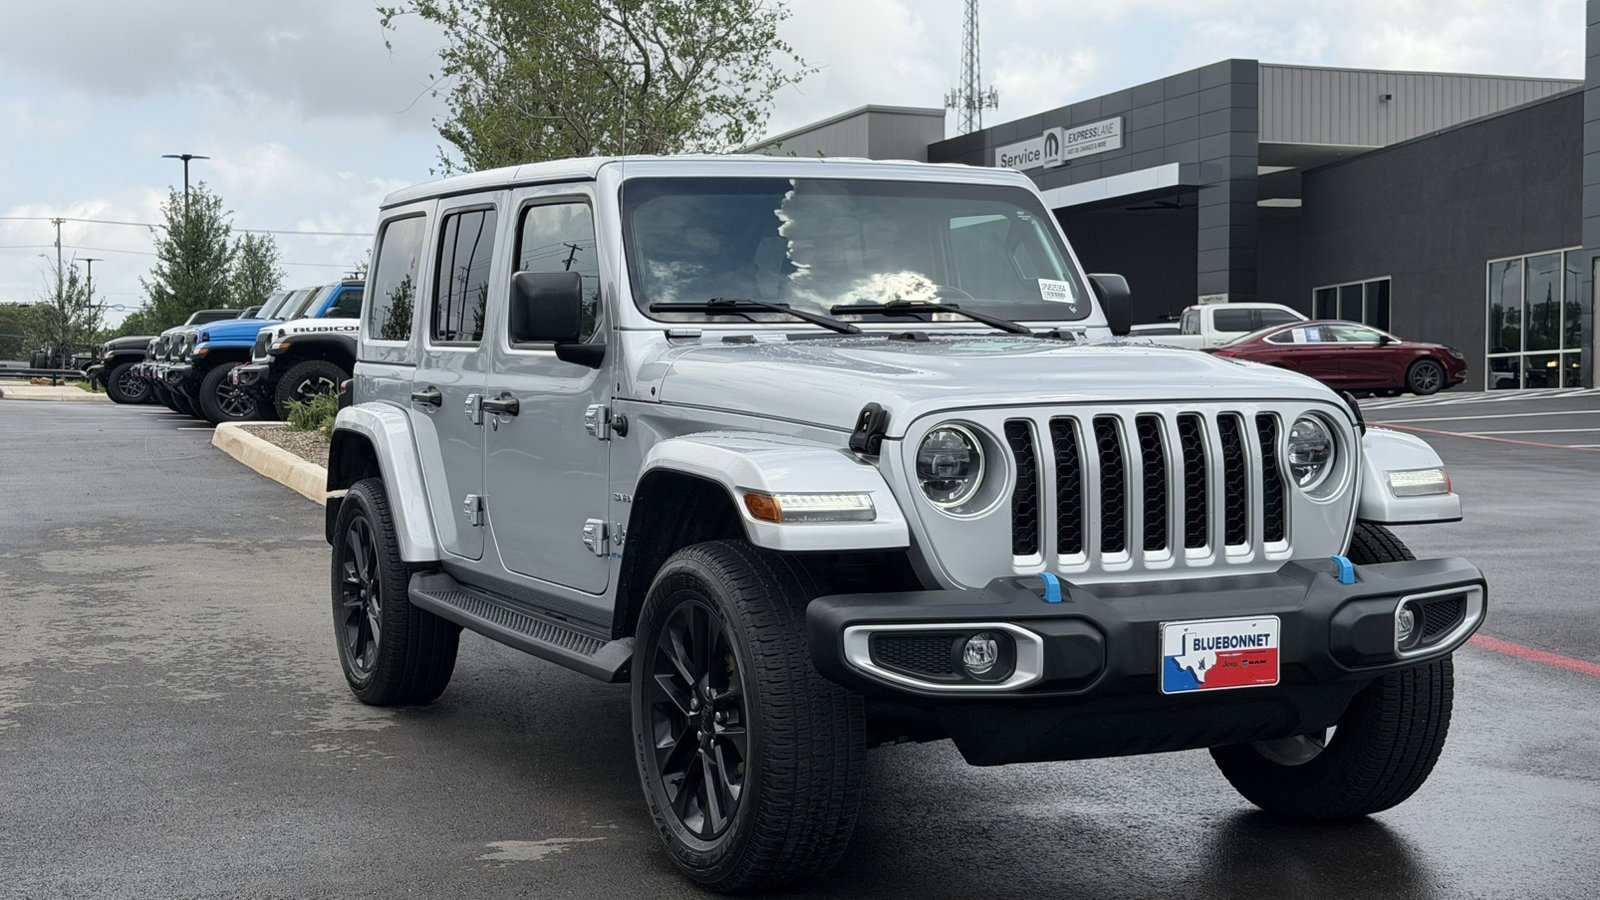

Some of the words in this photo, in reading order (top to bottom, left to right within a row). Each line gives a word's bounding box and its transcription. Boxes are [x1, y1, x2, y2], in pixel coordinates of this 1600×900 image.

[1000, 148, 1041, 168] Service
[1193, 633, 1271, 651] BLUEBONNET
[1222, 660, 1239, 669] Jeep
